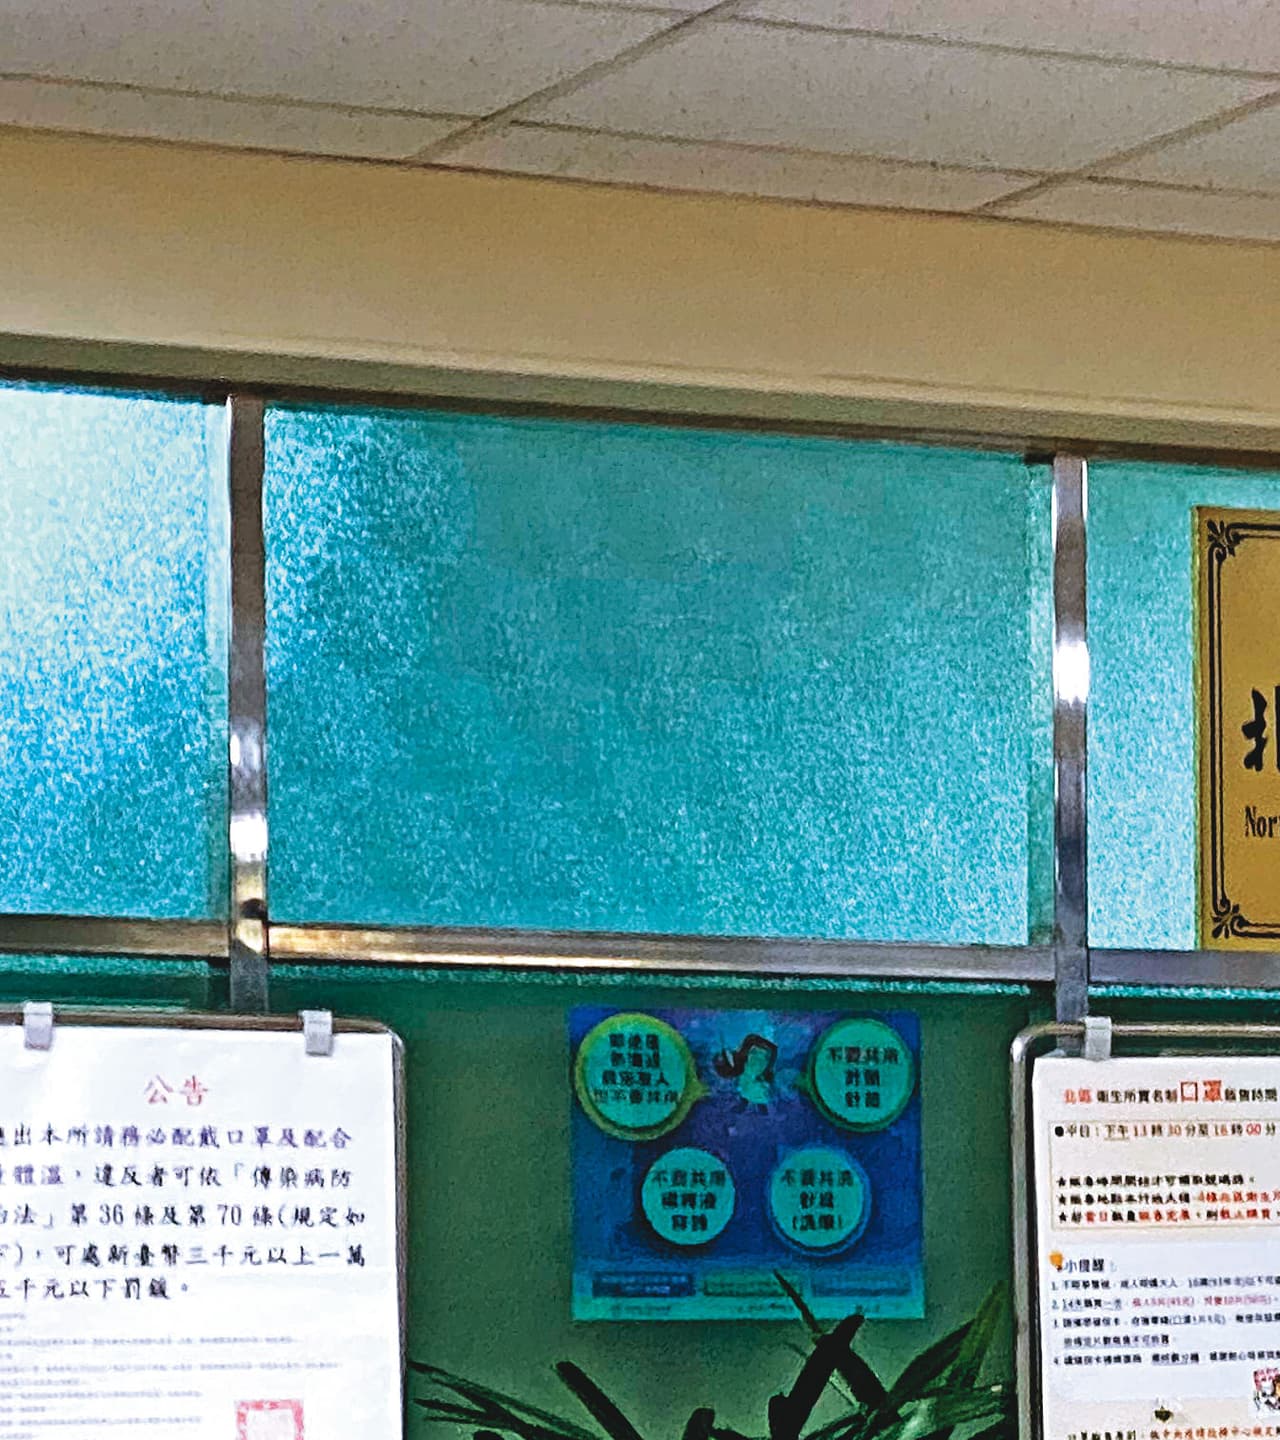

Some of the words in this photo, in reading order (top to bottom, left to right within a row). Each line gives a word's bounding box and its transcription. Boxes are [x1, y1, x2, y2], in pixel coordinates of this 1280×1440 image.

[144, 1075, 208, 1106] 公告
[0, 1124, 352, 1149] 出本所請務必配戴口罩及配合
[0, 1163, 353, 1188] 體溫，違反者可依「傳染病防
